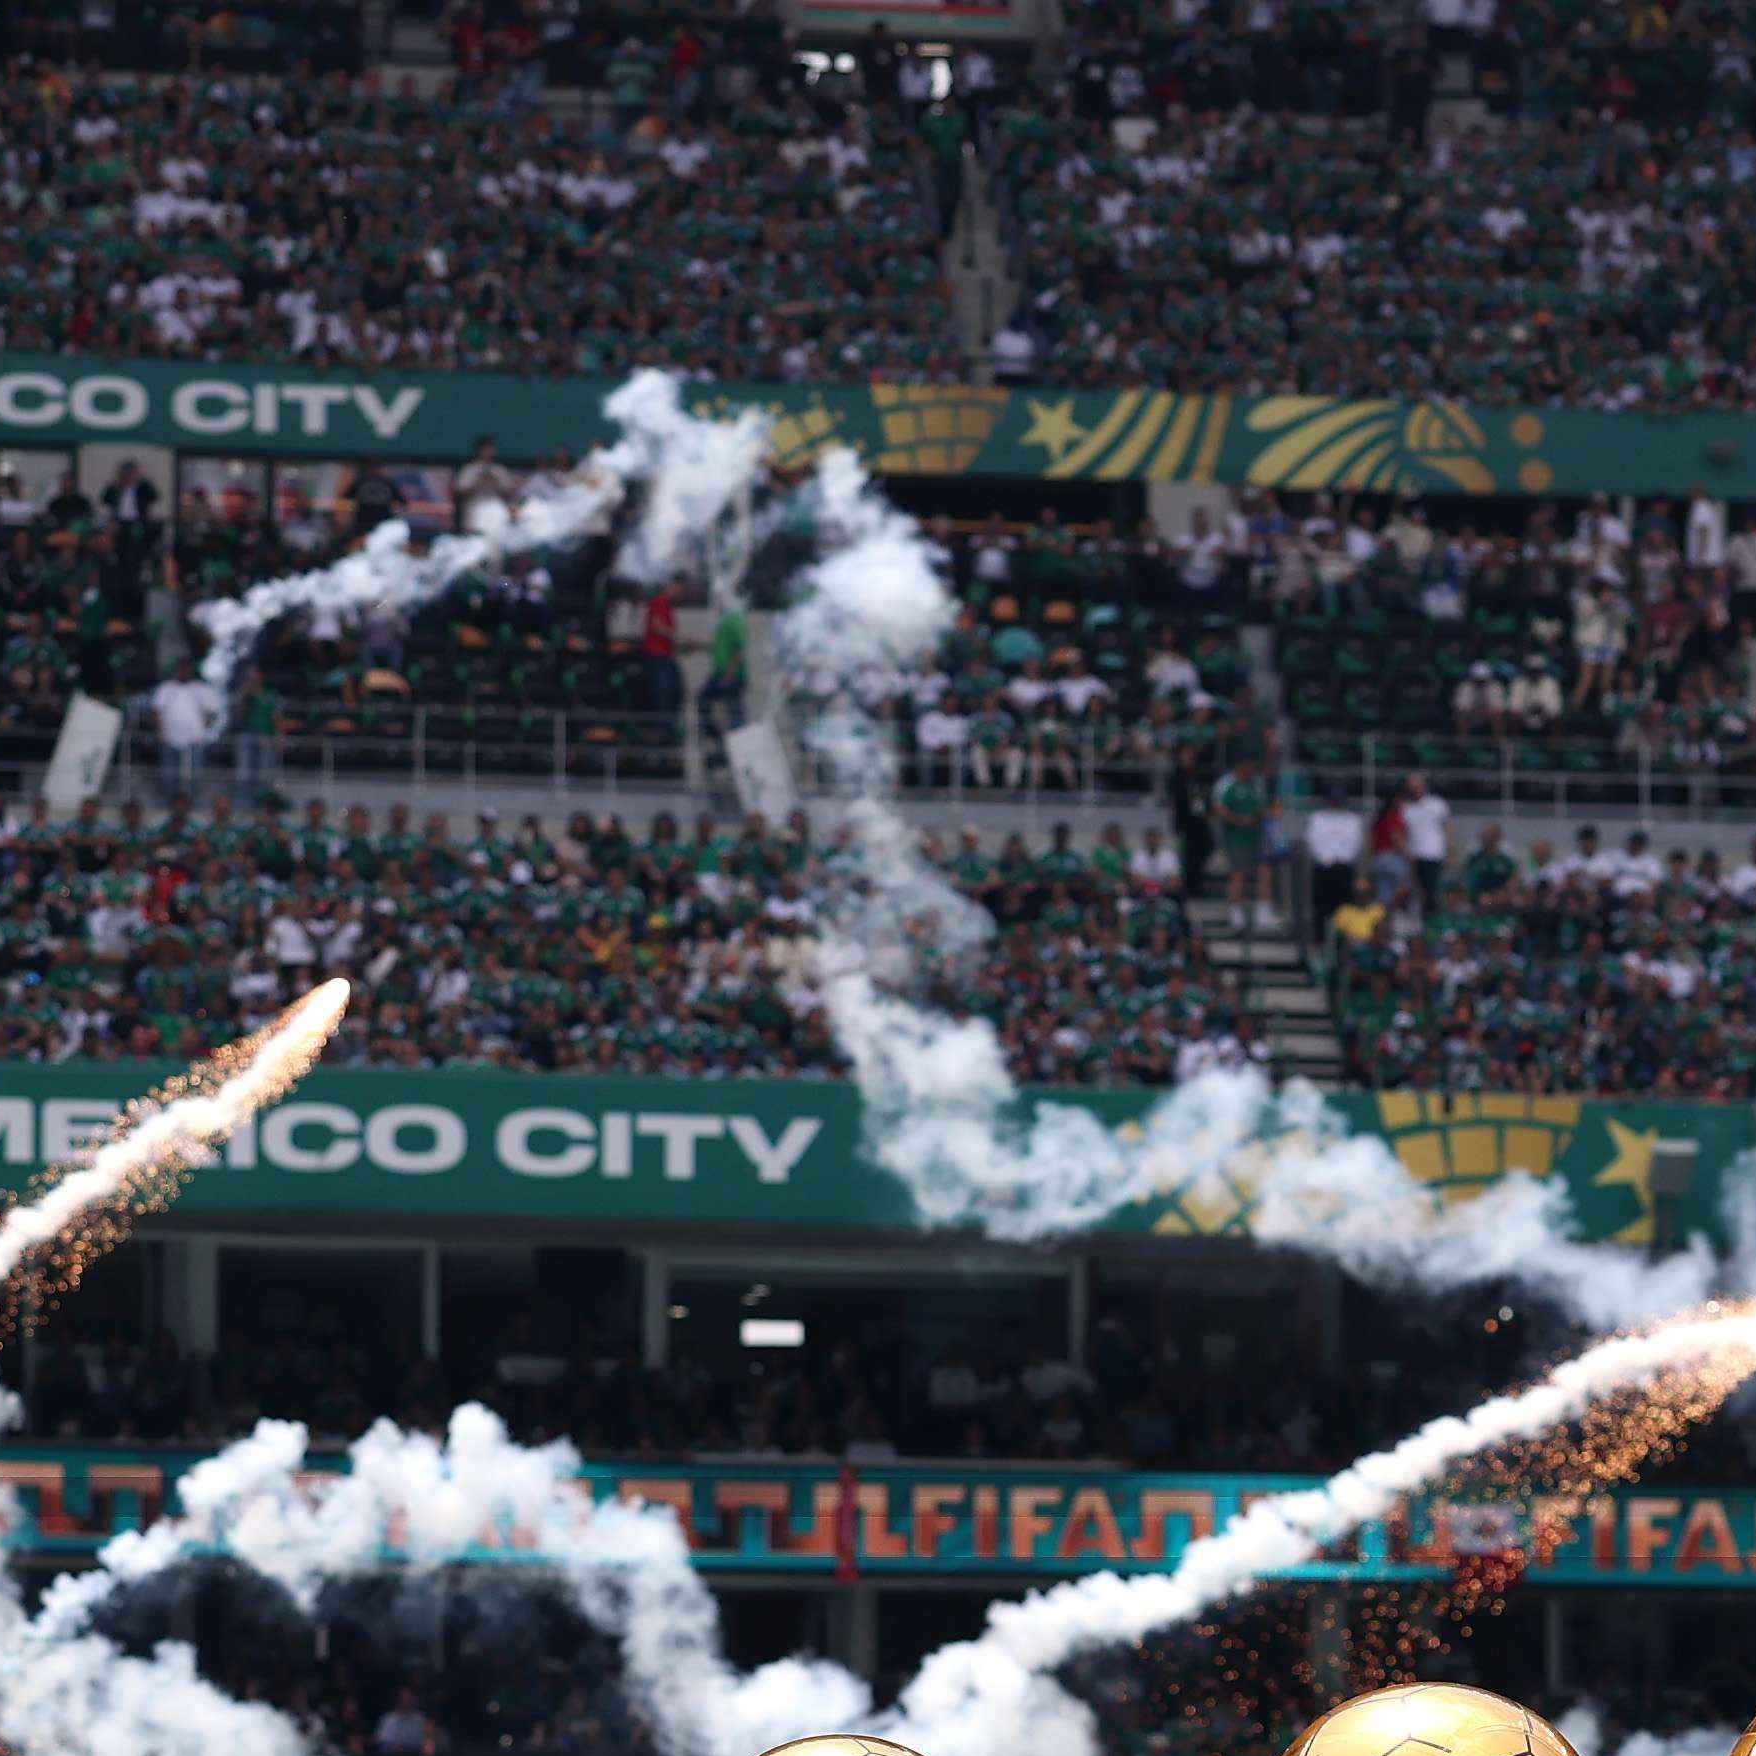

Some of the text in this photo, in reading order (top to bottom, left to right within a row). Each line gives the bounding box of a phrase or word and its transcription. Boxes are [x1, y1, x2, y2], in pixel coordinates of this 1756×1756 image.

[171, 379, 425, 439] CITY
[495, 1108, 822, 1184] CITY
[913, 1485, 1126, 1559] FIFA
[1534, 1497, 1742, 1573] FIFA
